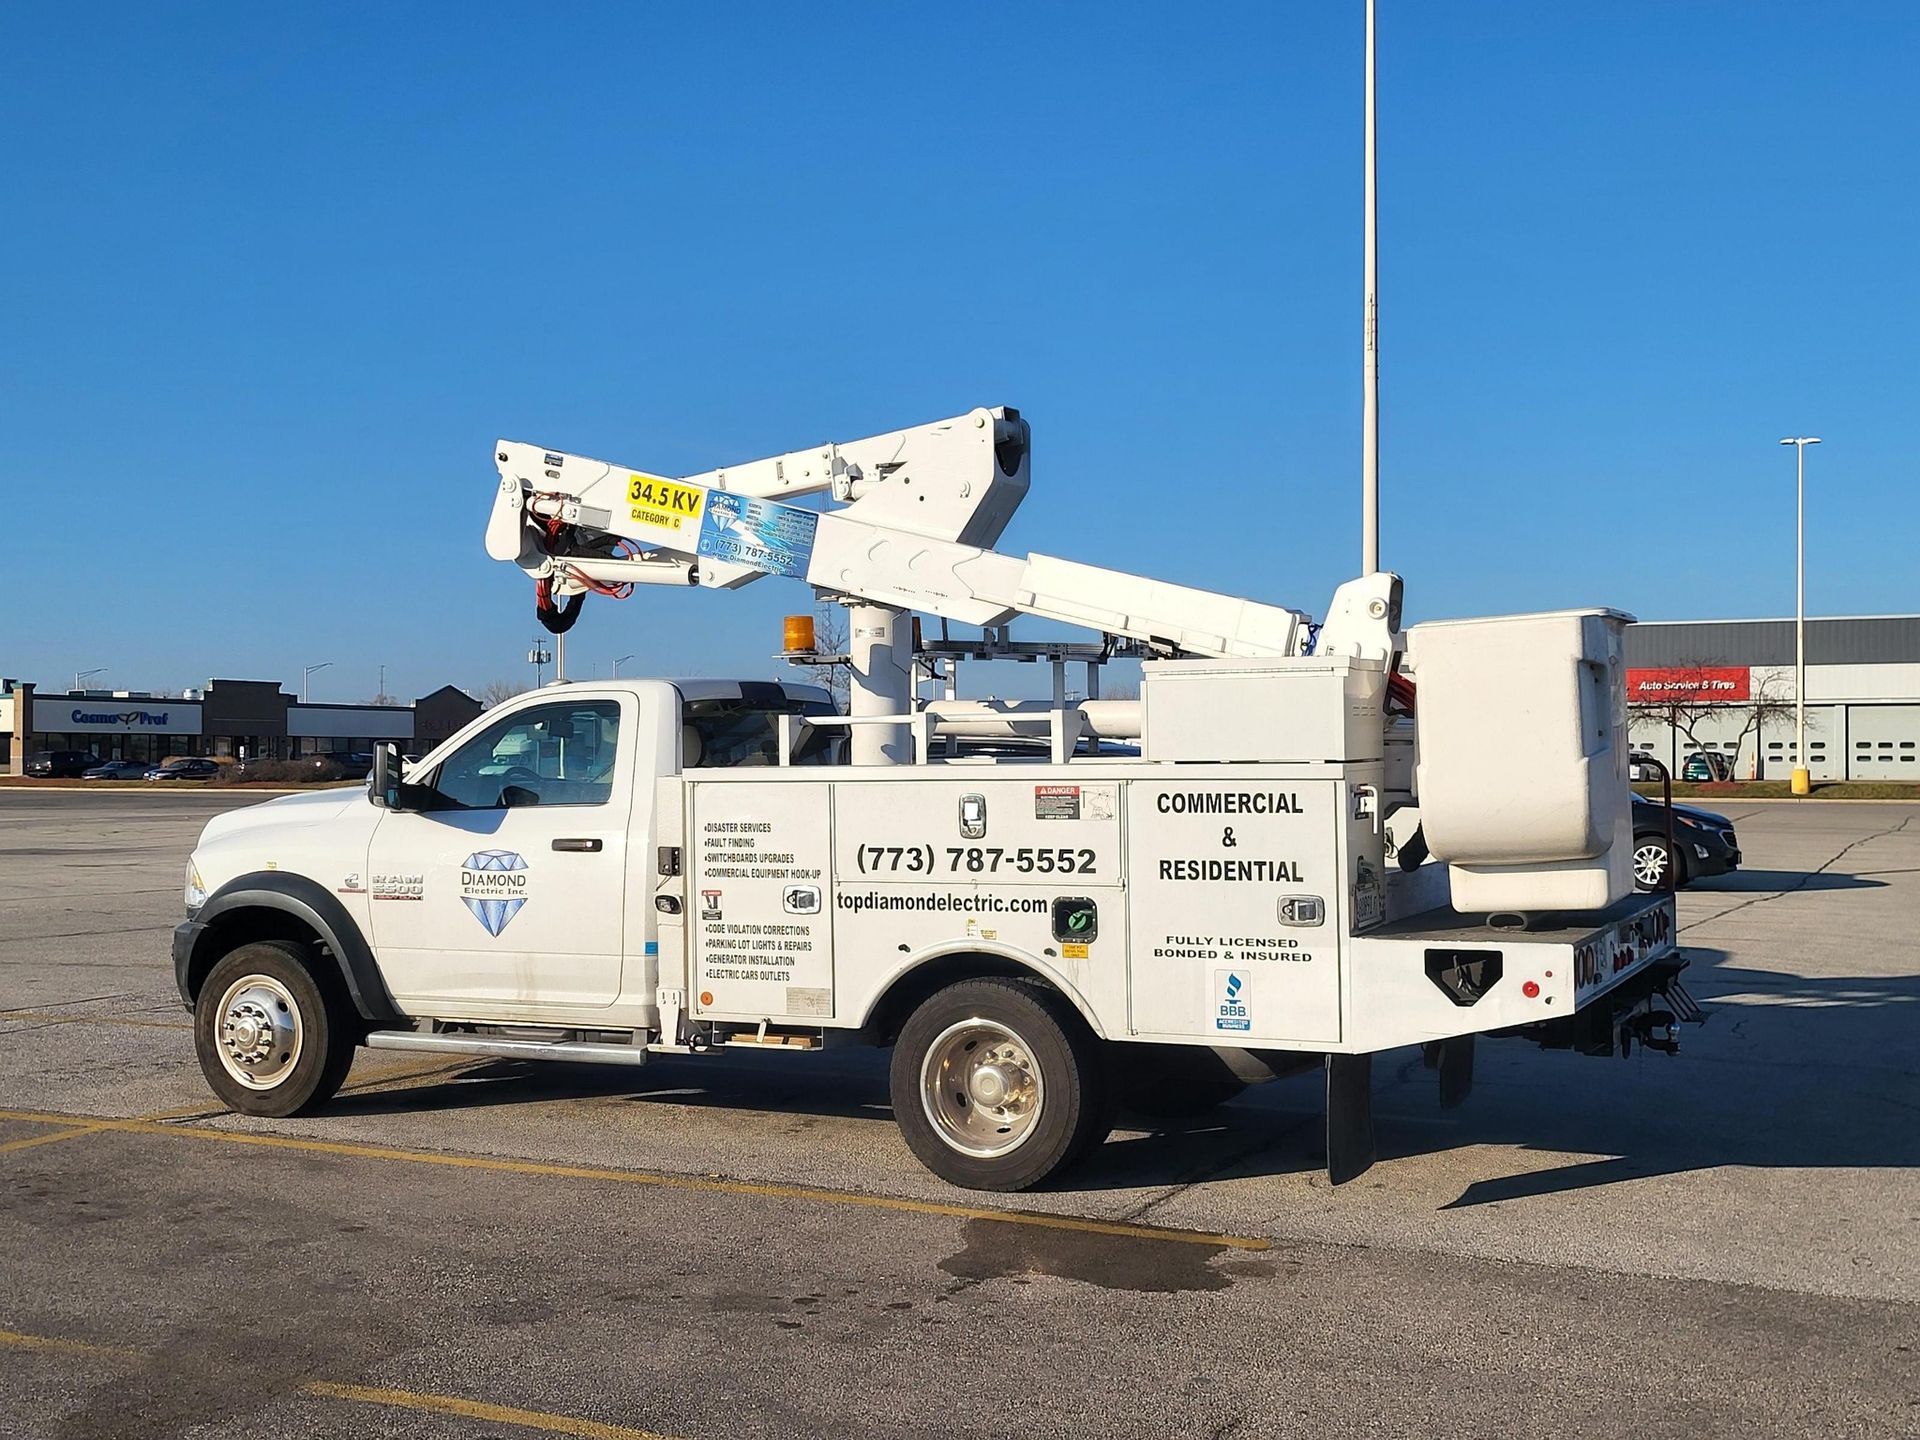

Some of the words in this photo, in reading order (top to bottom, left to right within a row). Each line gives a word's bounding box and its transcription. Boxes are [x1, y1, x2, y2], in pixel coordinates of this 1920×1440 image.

[631, 480, 670, 506] 34.5
[672, 489, 700, 513] KV
[631, 509, 670, 526] CATEGORY
[673, 518, 680, 528] C
[715, 539, 742, 555] (773)
[745, 545, 793, 567] 787-5552
[1639, 681, 1662, 690] Auto
[1663, 681, 1699, 690] Service
[1702, 680, 1709, 690] &
[1712, 680, 1735, 690] Tires
[71, 709, 119, 724] Cosmo
[139, 711, 169, 726] Prof
[1047, 787, 1076, 795] DANGER
[1157, 792, 1304, 814] COMMERCIAL
[707, 822, 738, 833] DISASTER
[739, 822, 772, 833] SERVICES
[707, 838, 727, 848] FAULT
[728, 838, 755, 848] FINDING
[1222, 826, 1237, 848] &
[707, 853, 758, 863] SWITCHBOARDS
[759, 853, 795, 864] UPGRADES
[857, 843, 935, 875] (773)
[946, 847, 1097, 875] 787-5552
[707, 868, 750, 878] COMMERCIAL
[751, 868, 789, 879] EQUIPMENT
[790, 869, 821, 880] HOOK-UP
[1159, 859, 1304, 883] RESIDENTIAL
[372, 873, 424, 884] RAM
[461, 871, 527, 887] DIAMOND
[372, 884, 424, 895] 5500
[464, 887, 504, 895] Electric
[507, 888, 528, 896] Inc.
[836, 891, 1048, 914] topdiamondelectric.com
[708, 923, 726, 934] CODE
[726, 924, 762, 935] VIOLATION
[762, 925, 810, 936] CORRECTIONS
[708, 939, 737, 949] PARKING
[738, 940, 751, 950] LOT
[752, 940, 776, 951] LIGHTS
[777, 941, 783, 951] &
[784, 941, 812, 952] REPAIRS
[1166, 935, 1215, 946] FULLY
[1219, 937, 1299, 949] LICENSED
[708, 954, 747, 965] GENERATOR
[748, 955, 795, 966] INSTALLATION
[1154, 948, 1218, 960] BONDED
[1223, 950, 1234, 960] &
[1240, 951, 1312, 962] INSURED
[709, 969, 740, 980] ELECTRIC
[740, 970, 759, 981] CARS
[760, 971, 790, 982] OUTLETS
[1220, 1005, 1246, 1017] BBB
